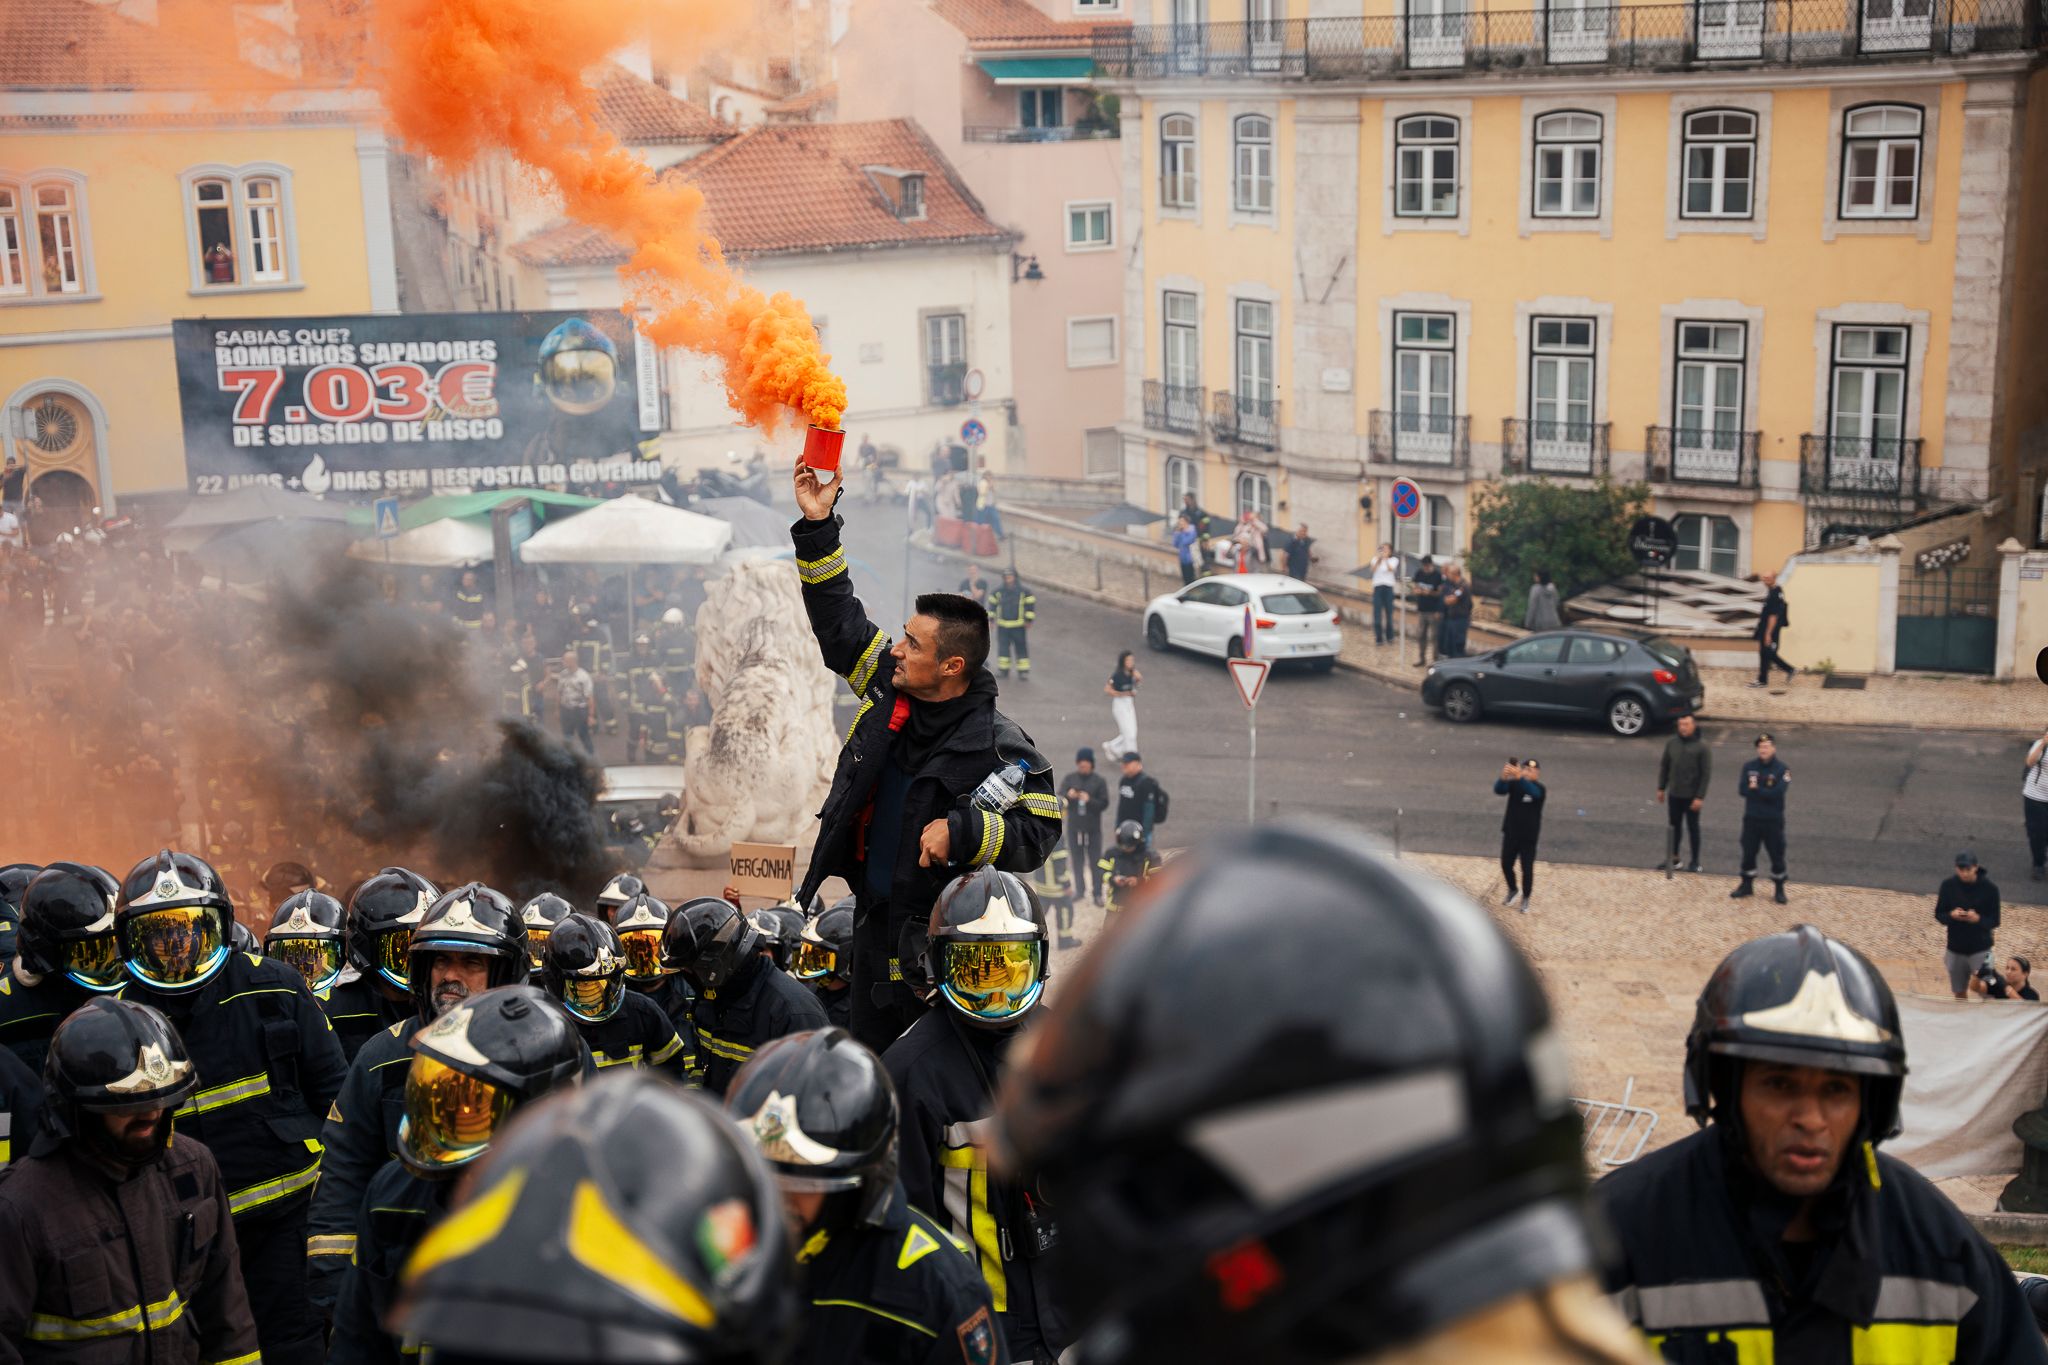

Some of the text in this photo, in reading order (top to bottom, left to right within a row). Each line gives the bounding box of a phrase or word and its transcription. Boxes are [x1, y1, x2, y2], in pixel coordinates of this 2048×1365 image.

[215, 328, 349, 347] SABIAS QUE?
[215, 340, 497, 367] BOMBEIROS SAPADORES
[216, 359, 499, 424] 7.03€
[232, 418, 504, 447] DE SUBSÍDIO DE RISCO
[197, 476, 224, 495] 22
[333, 470, 382, 491] DIAS
[384, 469, 428, 489] SEM
[431, 466, 536, 487] RESPOSTA
[538, 464, 567, 484] DO
[569, 460, 662, 483] GOVERNO
[730, 857, 793, 880] VERGONHA
